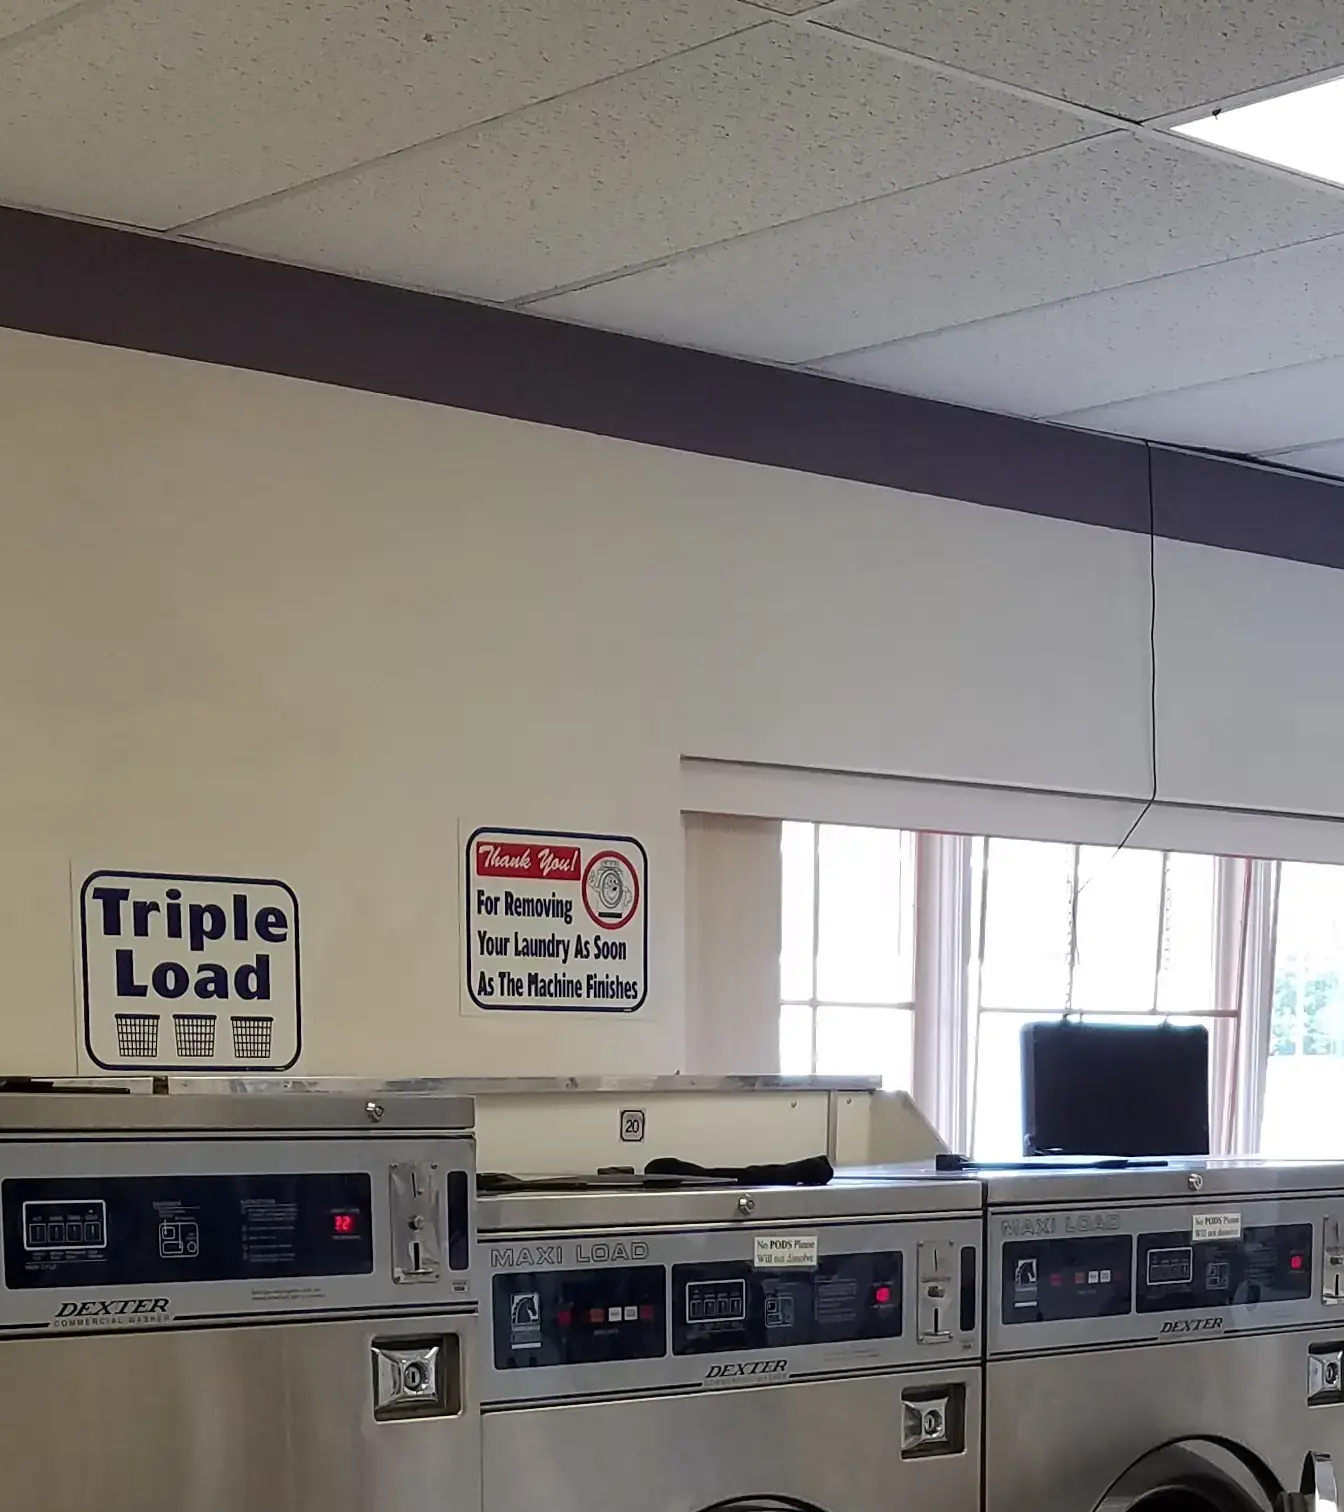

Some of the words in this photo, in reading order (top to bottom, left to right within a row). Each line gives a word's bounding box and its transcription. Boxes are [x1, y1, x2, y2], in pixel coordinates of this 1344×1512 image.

[478, 845, 532, 869] Thank
[537, 848, 579, 876] You!
[92, 887, 288, 952] Triple
[476, 889, 501, 916] For
[504, 890, 573, 925] Removing
[477, 930, 510, 957] Your
[513, 931, 571, 964] Laundry
[574, 934, 591, 960] As
[593, 935, 627, 961] Soon
[114, 948, 271, 1001] Load
[477, 971, 494, 997] As
[497, 971, 524, 997] The
[527, 972, 583, 999] Machine
[586, 974, 638, 1000] Finishes
[624, 1118, 640, 1134] 20
[1001, 1217, 1057, 1236] MAXI
[1065, 1213, 1121, 1233] LOAD
[490, 1246, 563, 1268] MAXI
[576, 1241, 649, 1263] LOAD
[770, 1240, 793, 1249] PODS
[55, 1298, 171, 1318] DEXTER
[1160, 1317, 1223, 1333] DEXTER
[705, 1360, 788, 1378] DEXTER
